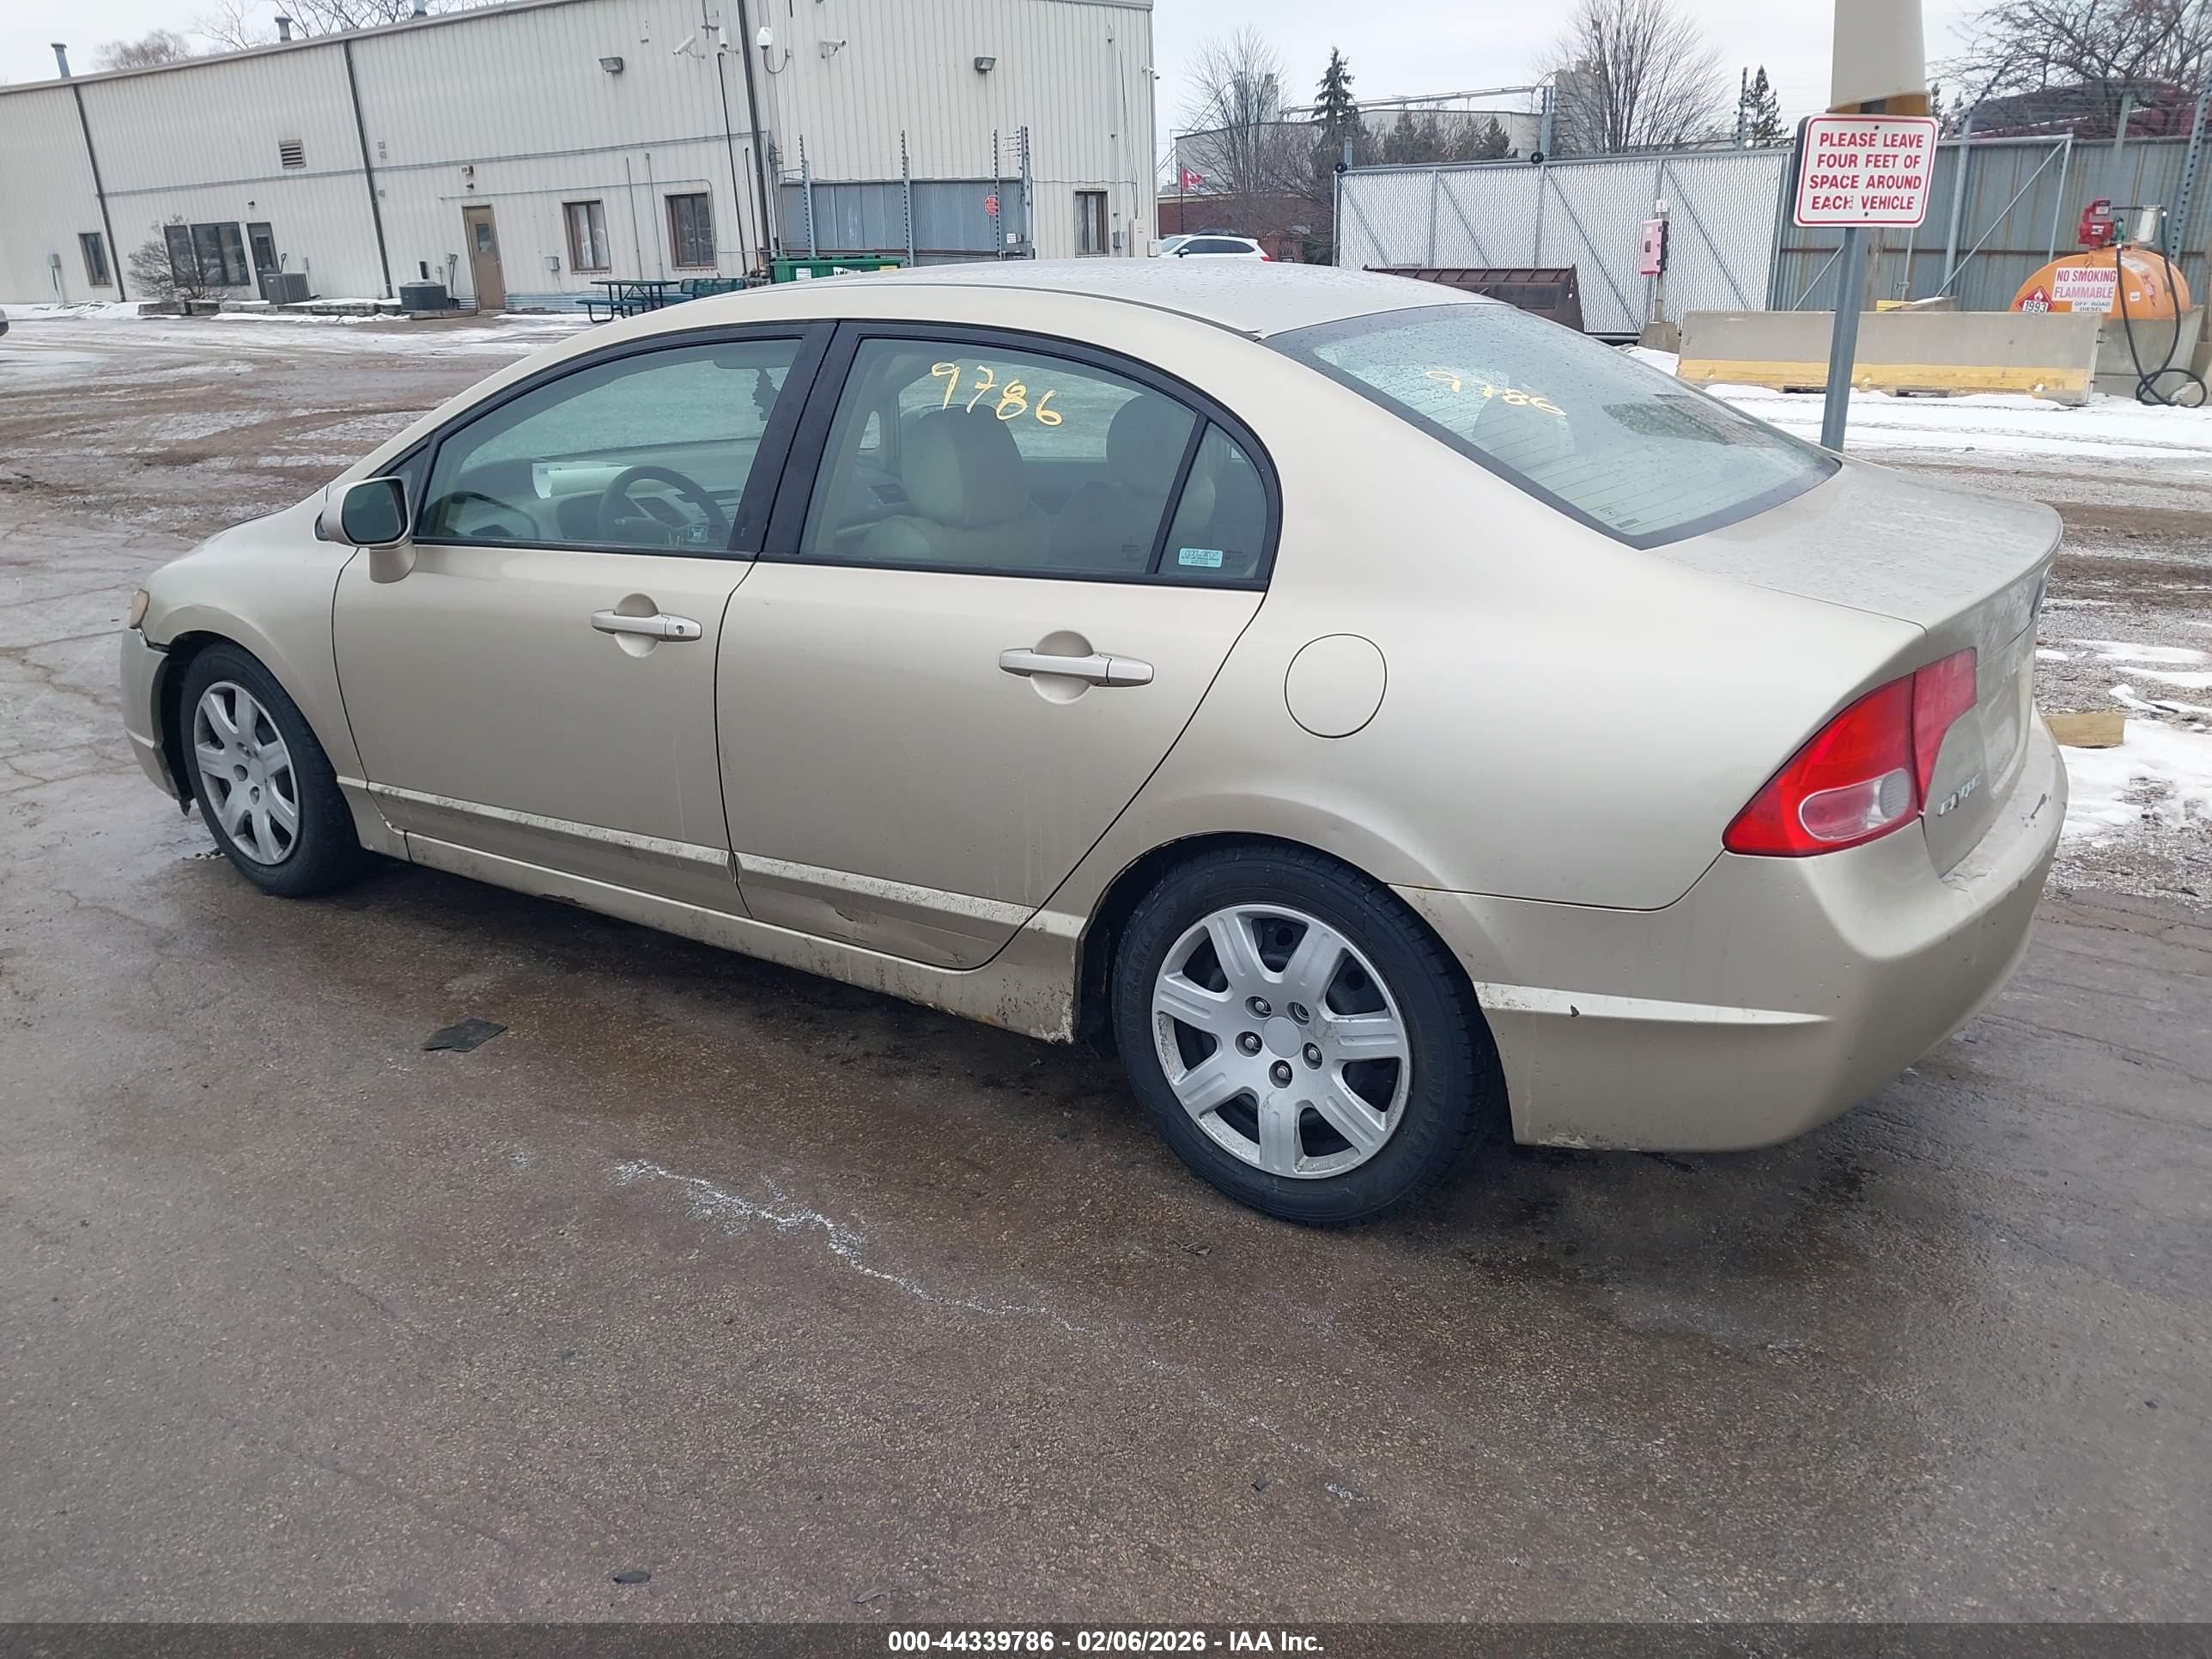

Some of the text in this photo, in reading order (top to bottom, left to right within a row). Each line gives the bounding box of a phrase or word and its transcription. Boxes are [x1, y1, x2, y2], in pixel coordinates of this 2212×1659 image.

[1820, 132, 1924, 149] PLEASE LEAVE
[1817, 153, 1921, 169] FOUR FEET OF
[1809, 174, 1922, 190] SPACE AROUND
[1811, 195, 1914, 210] EACH VEHICLE
[2057, 270, 2117, 283] NO SMOKING
[2054, 287, 2114, 299] FLAMMABLE
[2025, 301, 2047, 313] 1993
[932, 362, 1063, 426] 9786
